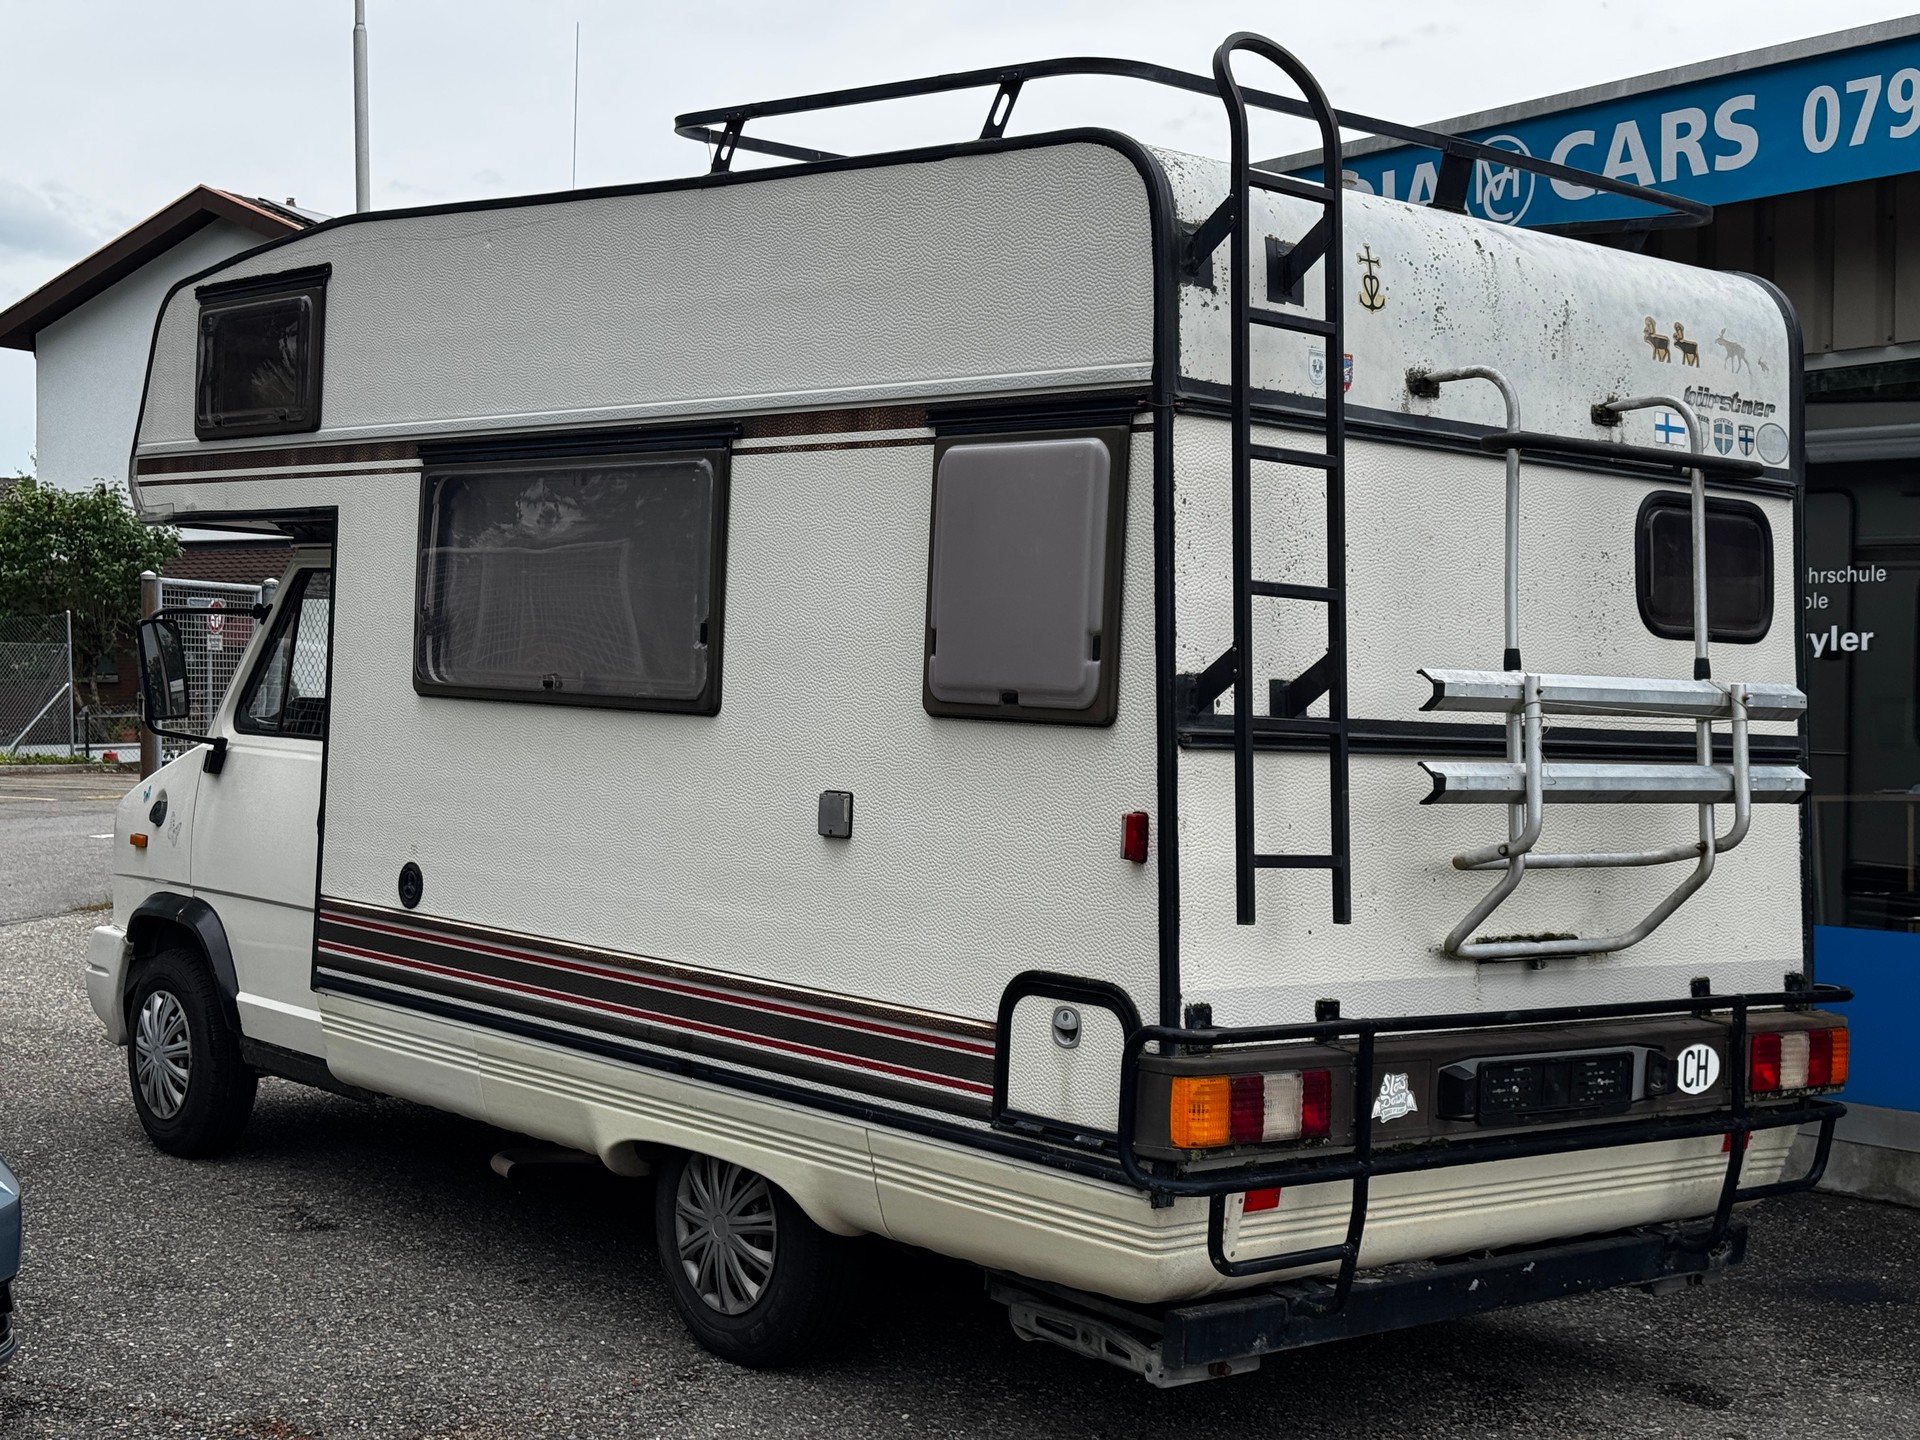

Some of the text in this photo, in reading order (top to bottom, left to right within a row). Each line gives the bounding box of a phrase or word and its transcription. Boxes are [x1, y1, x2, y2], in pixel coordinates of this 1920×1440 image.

[1343, 162, 1440, 207] IA
[1550, 94, 1759, 201] CARS
[1802, 67, 1920, 154] 079
[1683, 385, 1776, 418] bürstner
[1806, 564, 1887, 584] hrschule
[1806, 625, 1875, 658] yler
[1683, 1048, 1710, 1088] CH
